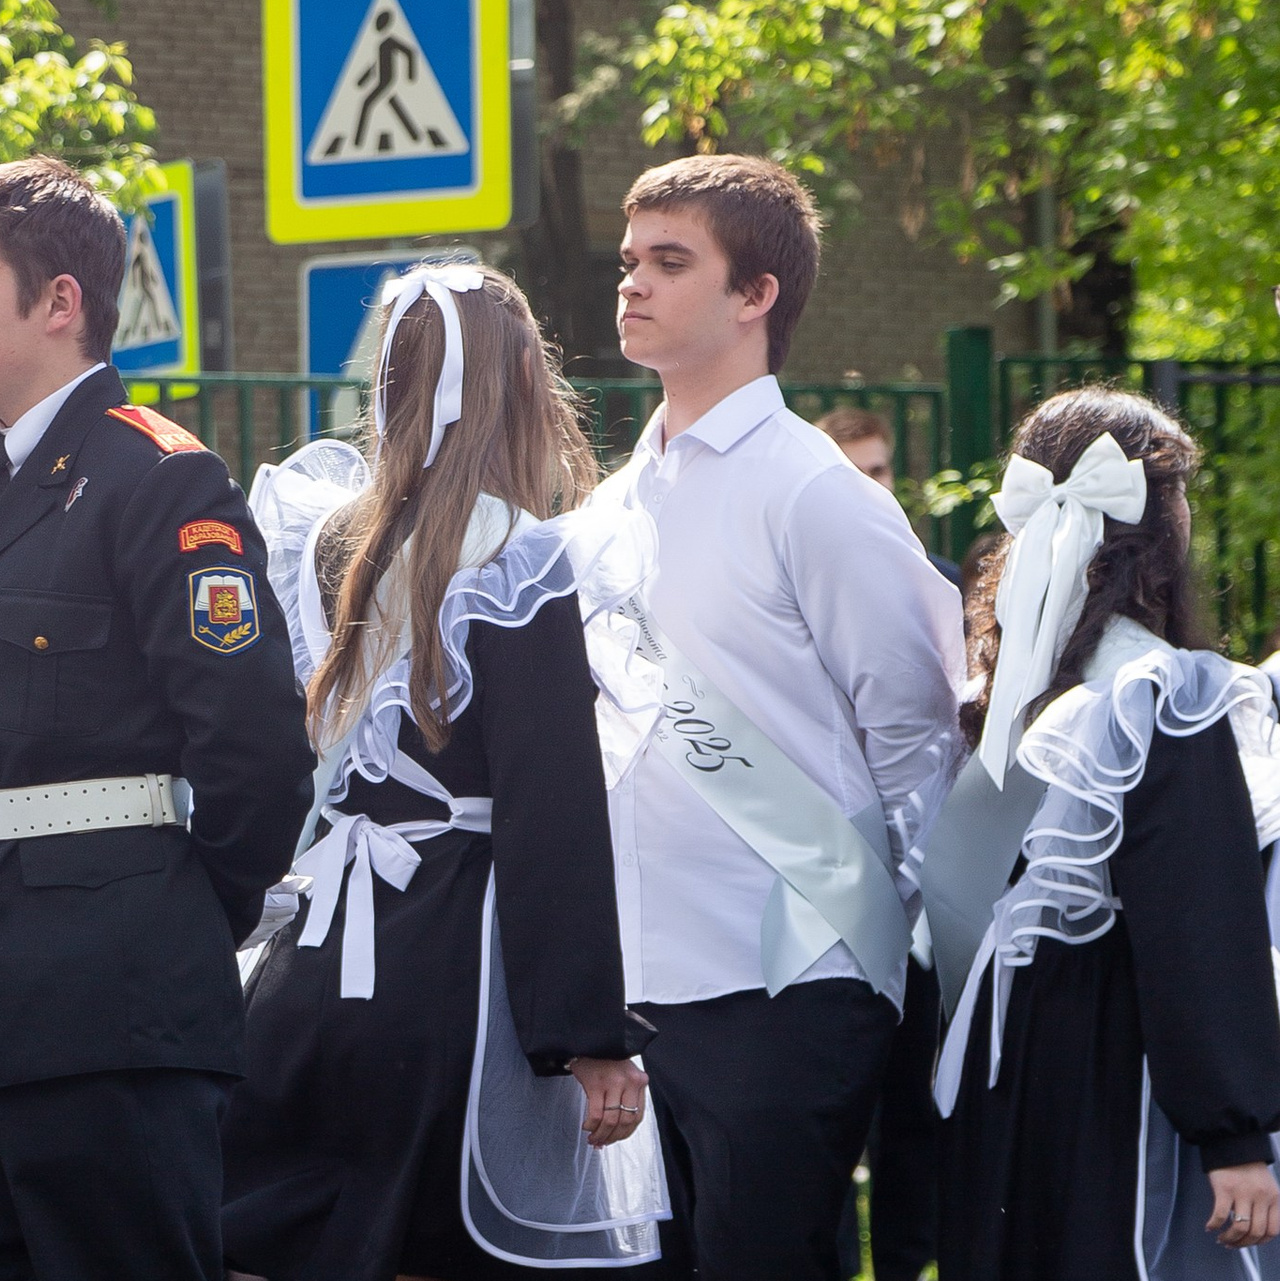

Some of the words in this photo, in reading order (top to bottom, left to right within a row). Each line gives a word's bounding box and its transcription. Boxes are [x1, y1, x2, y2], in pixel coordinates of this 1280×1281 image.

[628, 595, 641, 615] ков
[636, 612, 668, 662] Никита
[663, 700, 755, 773] 2025
